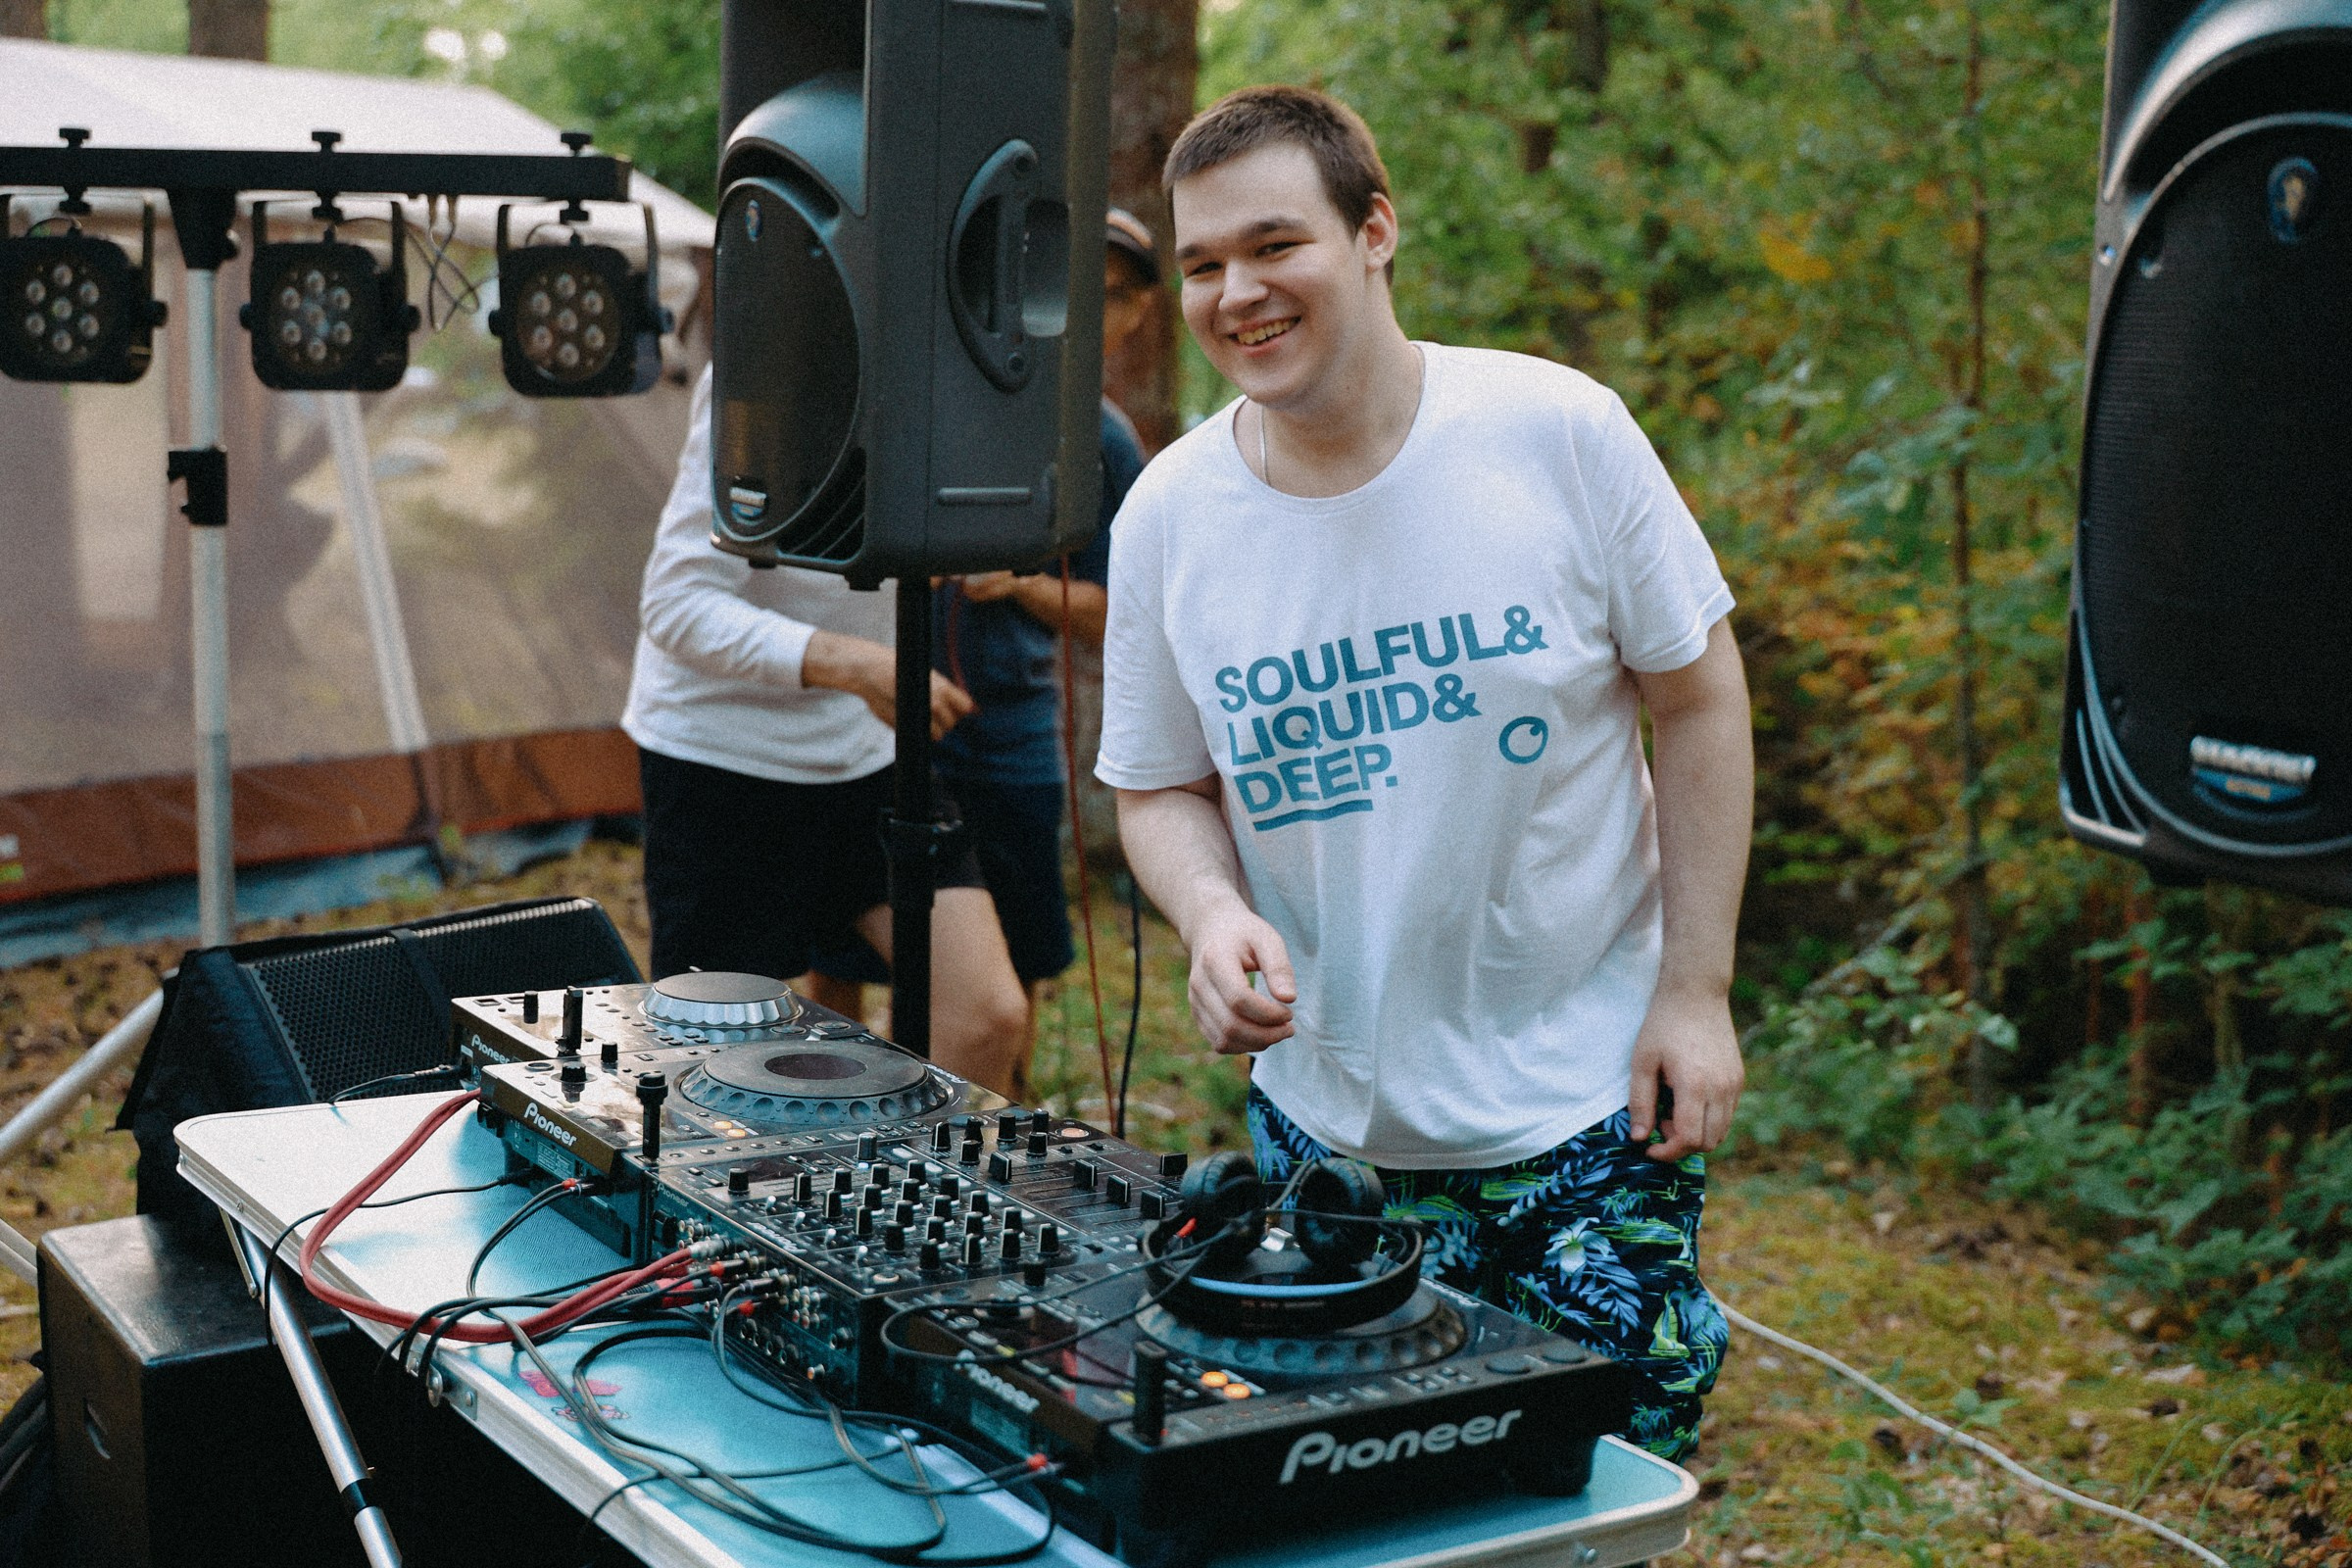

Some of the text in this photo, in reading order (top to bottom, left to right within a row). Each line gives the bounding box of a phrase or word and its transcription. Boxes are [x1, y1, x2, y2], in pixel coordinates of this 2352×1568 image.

[1215, 605, 1549, 713] SOULFUL&
[1227, 673, 1483, 766] LIQUID&
[1232, 743, 1398, 814] DEEP.
[523, 1102, 577, 1147] Pioneer
[1280, 1409, 1523, 1485] Pioneer
